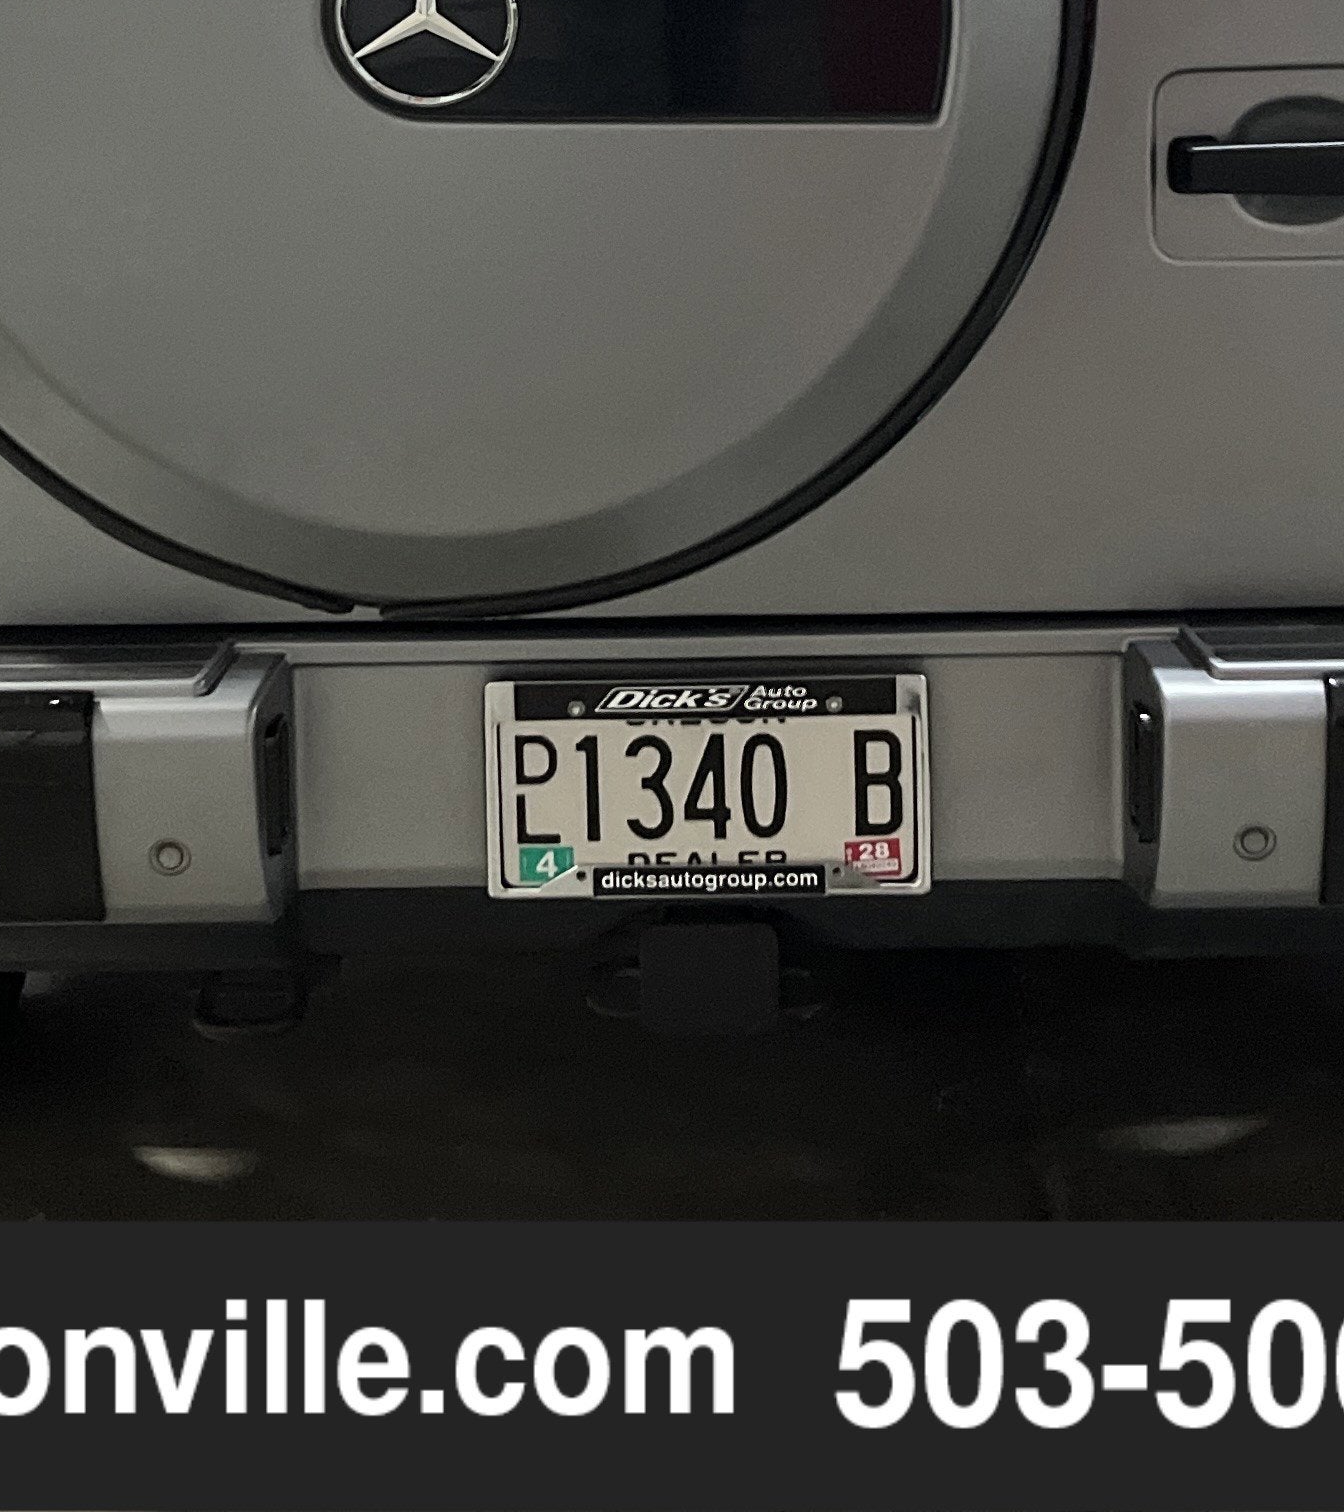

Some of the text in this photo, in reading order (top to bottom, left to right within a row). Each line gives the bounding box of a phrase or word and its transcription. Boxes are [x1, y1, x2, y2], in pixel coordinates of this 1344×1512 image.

[606, 685, 807, 709] Dick's Auto
[743, 697, 818, 713] Group
[575, 733, 788, 842] 1340
[853, 729, 904, 837] B
[858, 841, 890, 860] 28
[535, 850, 558, 878] 4
[601, 871, 819, 892] dicksautogroup.com
